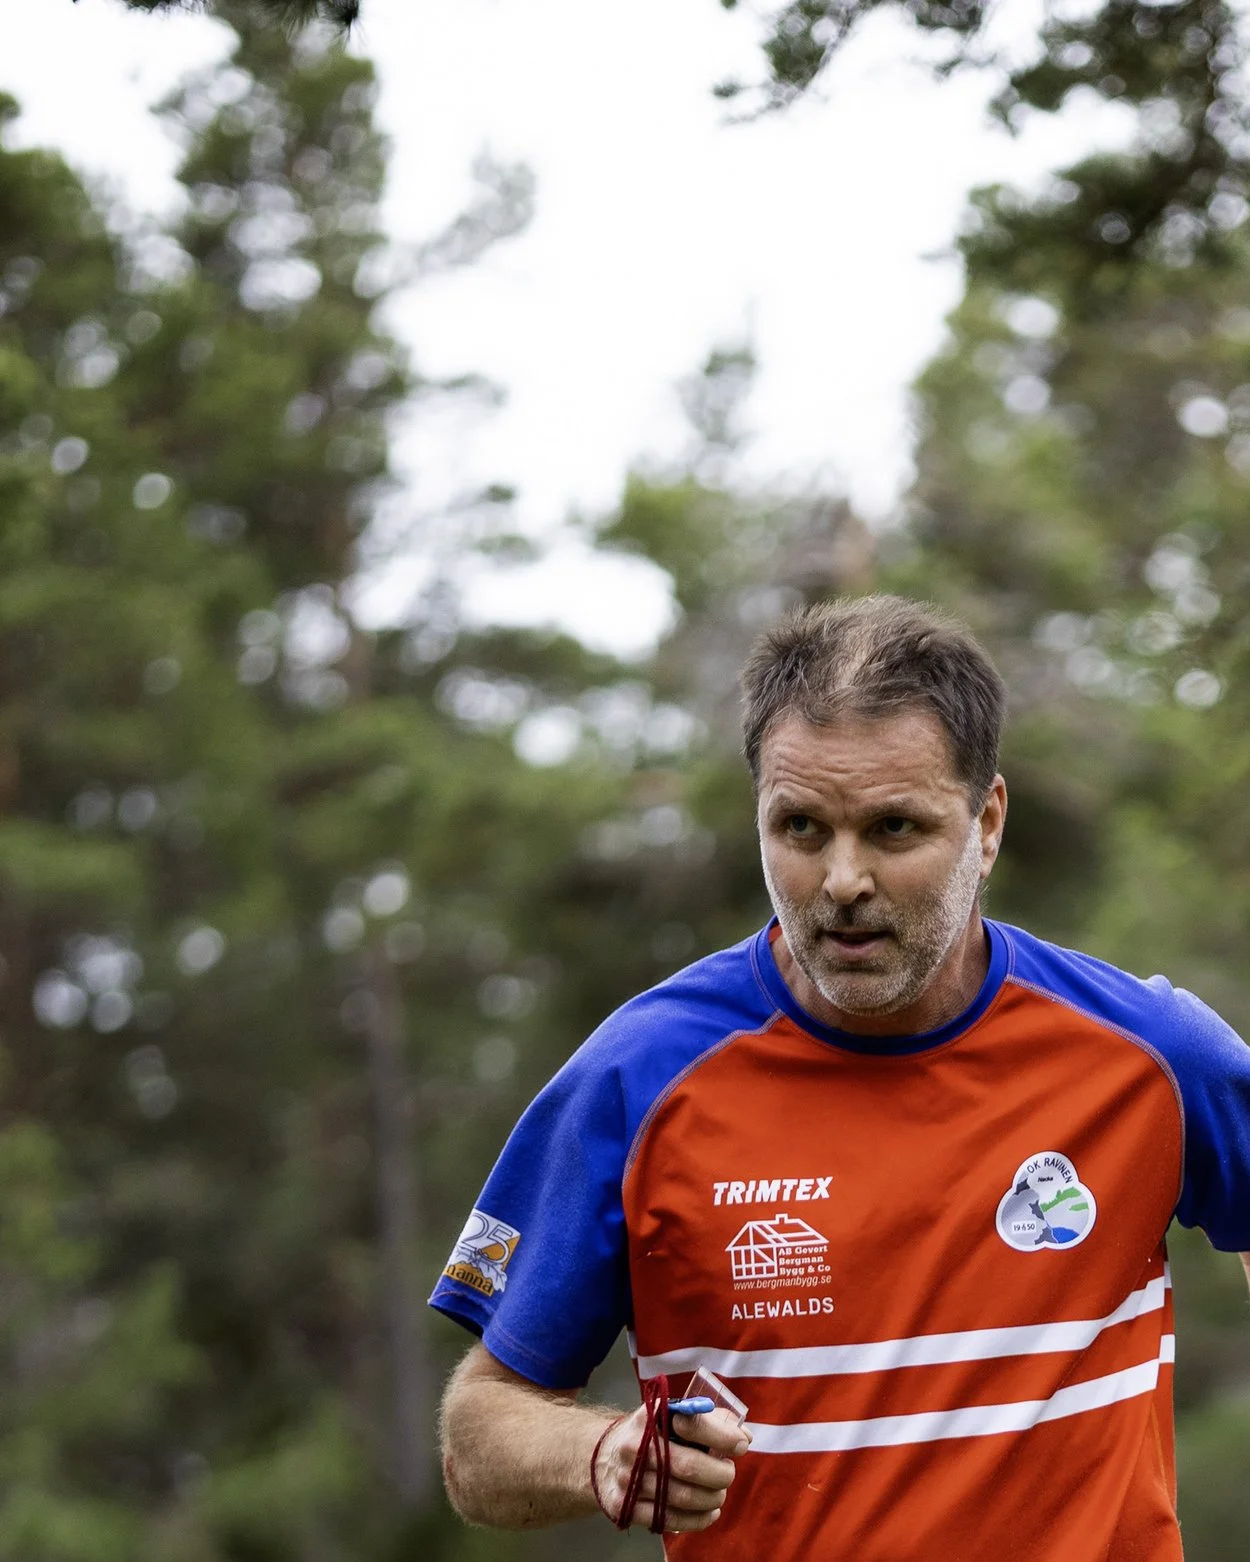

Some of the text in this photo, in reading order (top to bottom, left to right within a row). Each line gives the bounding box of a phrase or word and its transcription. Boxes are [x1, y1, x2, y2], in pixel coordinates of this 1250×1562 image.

[1027, 1157, 1073, 1184] OK RAVINEN
[713, 1176, 833, 1206] TRIMTEX
[458, 1212, 513, 1263] 25
[778, 1247, 792, 1256] AB
[779, 1256, 824, 1266] Bergman
[779, 1267, 805, 1276] Bygg
[817, 1264, 831, 1272] Co
[733, 1275, 832, 1290] www.bergmanbygg.se
[731, 1297, 834, 1320] ALEWALDS
